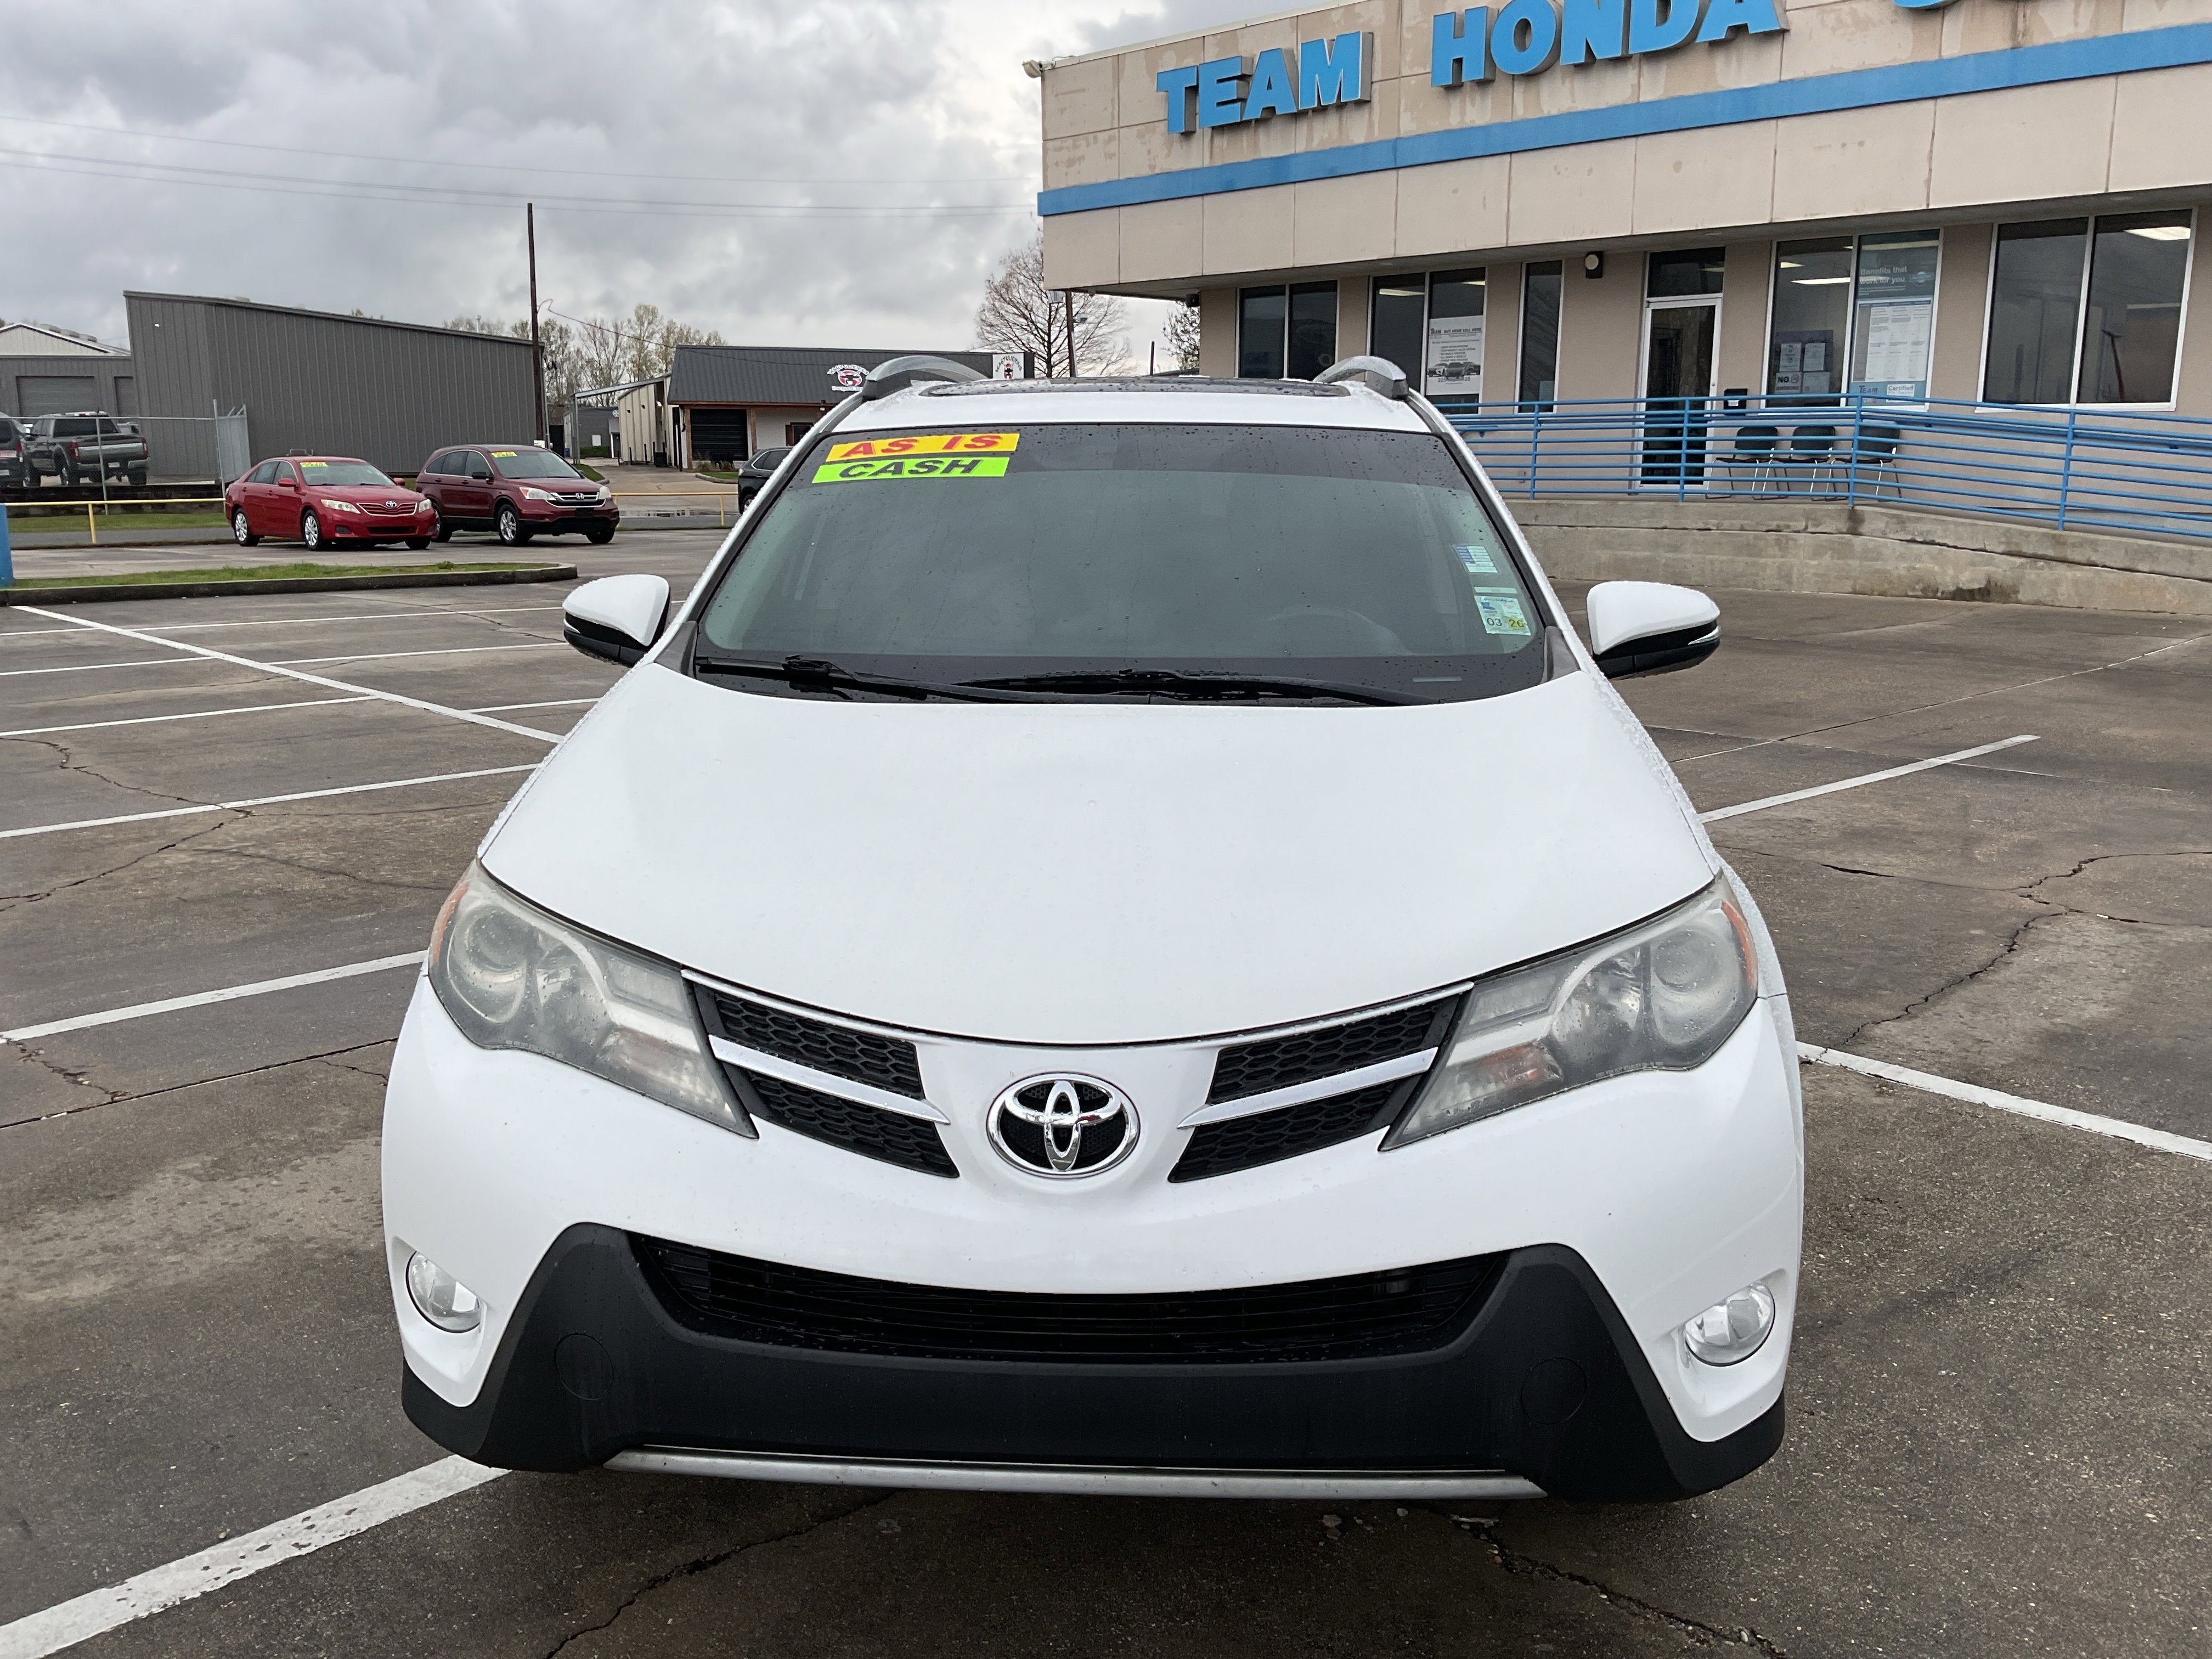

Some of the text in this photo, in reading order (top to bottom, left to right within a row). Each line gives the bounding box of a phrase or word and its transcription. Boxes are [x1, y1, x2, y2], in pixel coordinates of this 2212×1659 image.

[1156, 0, 1782, 134] TEAM HONDA
[1859, 385, 1878, 394] TEAM
[840, 435, 1003, 458] AS IS
[839, 459, 984, 478] CASH
[1487, 618, 1525, 628] 03 26
